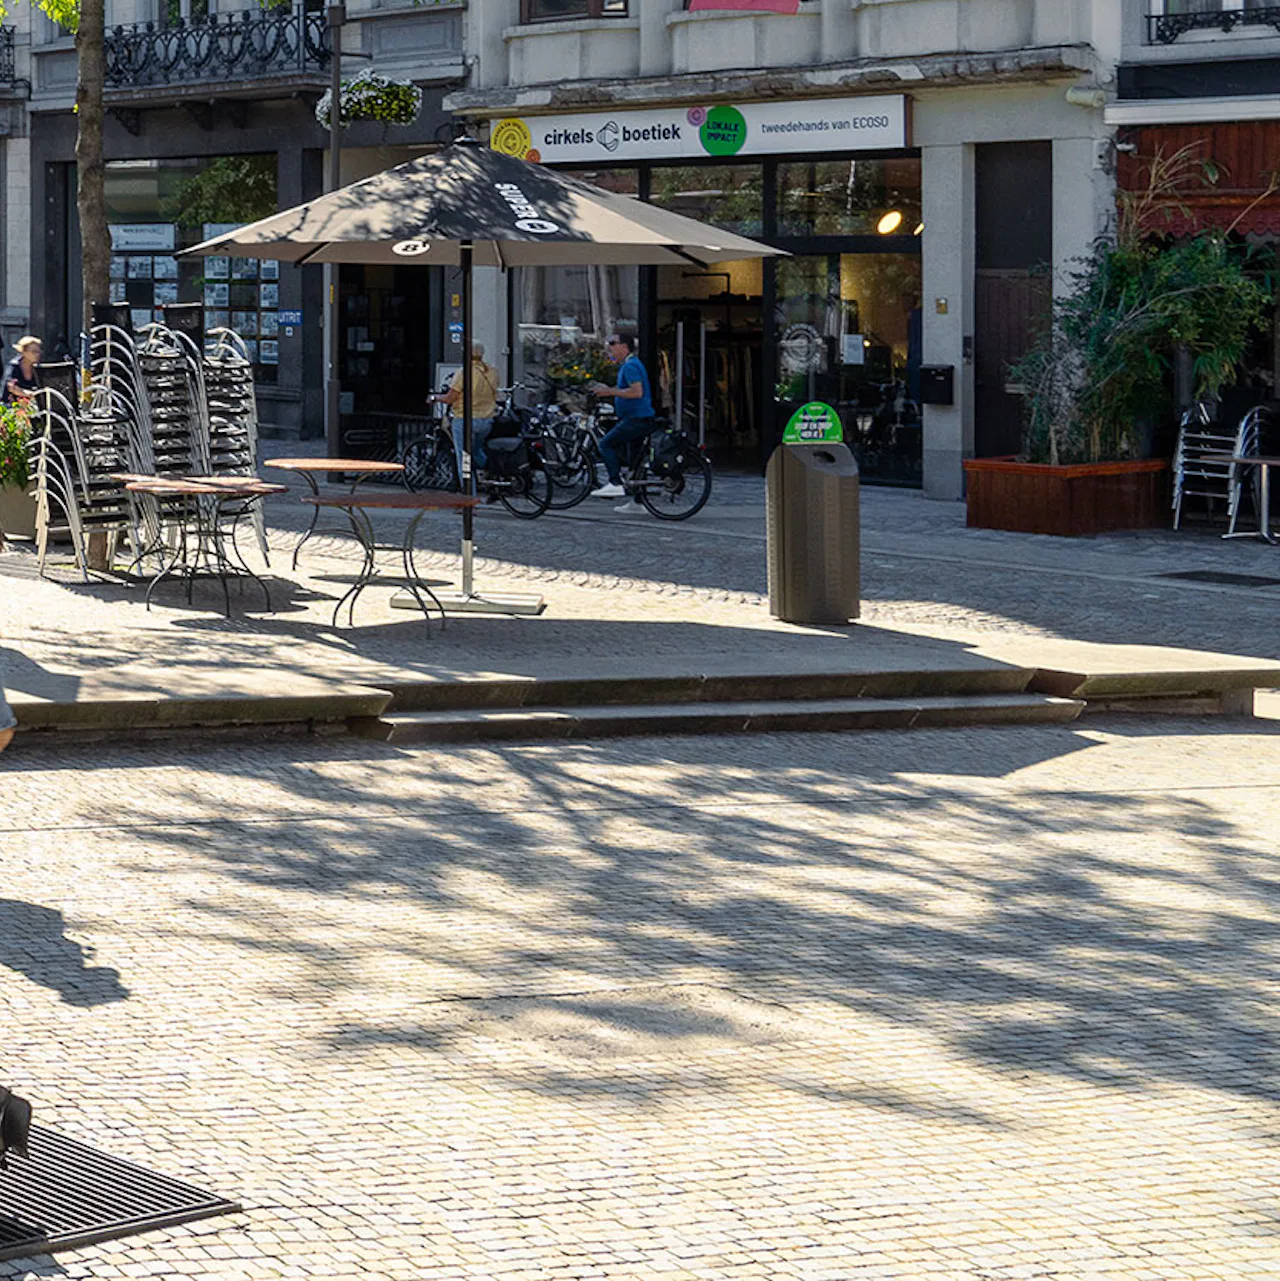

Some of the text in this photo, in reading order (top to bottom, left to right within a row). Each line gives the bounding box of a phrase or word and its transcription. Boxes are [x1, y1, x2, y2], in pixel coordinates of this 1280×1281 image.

[544, 128, 594, 145] cirkels
[622, 123, 681, 142] boetiek
[706, 121, 739, 132] LOKALE
[761, 116, 889, 134] tweedehands van ECOSO
[706, 132, 738, 143] IMPACT
[495, 182, 539, 218] SUPER
